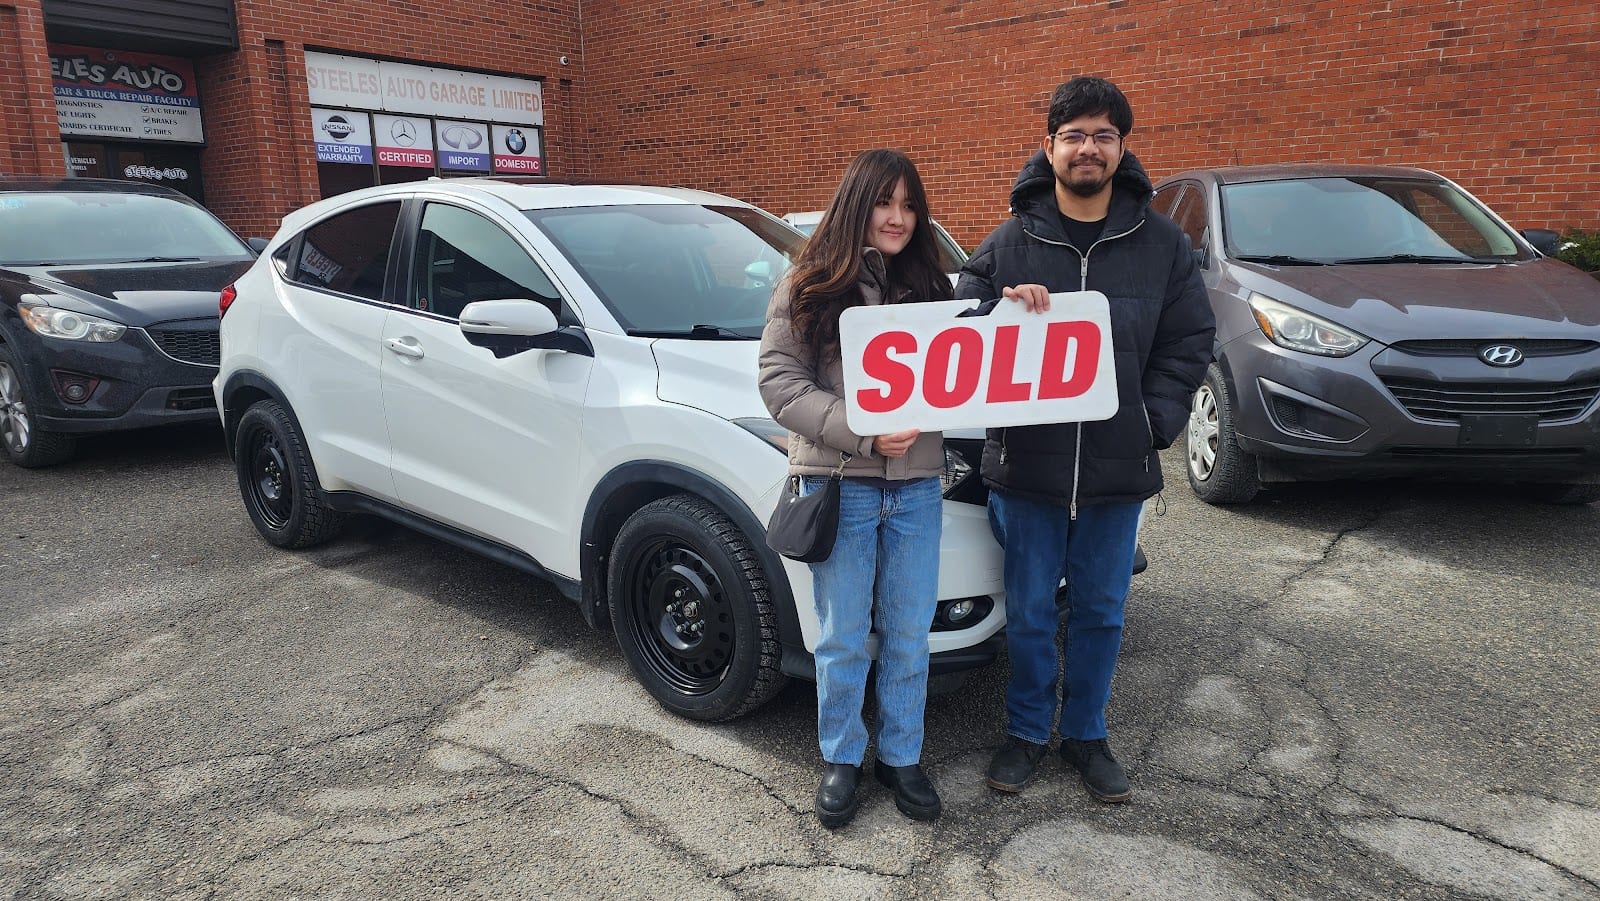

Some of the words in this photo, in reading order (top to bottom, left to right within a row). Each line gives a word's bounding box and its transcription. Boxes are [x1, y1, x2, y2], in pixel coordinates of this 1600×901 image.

[112, 64, 183, 92] AUTO
[307, 66, 379, 96] STEELES
[387, 76, 426, 100] AUTO
[429, 81, 486, 107] GARAGE
[492, 88, 540, 112] LIMITED
[54, 86, 73, 96] CAR
[75, 87, 83, 97] &
[86, 89, 117, 100] TRUCK
[119, 92, 153, 103] REPAIR
[155, 95, 192, 106] FACILITY
[55, 99, 103, 109] DIAGNOSTICS
[70, 111, 97, 119] LIGHTS
[163, 108, 188, 116] REPAIR
[151, 117, 178, 126] BRAKES
[89, 123, 133, 133] CERTIFICATE
[153, 128, 173, 136] TIRES
[324, 123, 352, 131] NISSAN
[318, 144, 361, 154] EXTENDED
[71, 156, 97, 165] VEHICLES
[317, 153, 363, 163] WARRANTY
[379, 151, 432, 164] CERTIFIED
[448, 155, 480, 166] IMPORT
[495, 158, 539, 170] DOMESTIC
[124, 164, 162, 180] STEELES
[162, 167, 188, 180] AUTO
[857, 320, 1102, 413] SOLD
